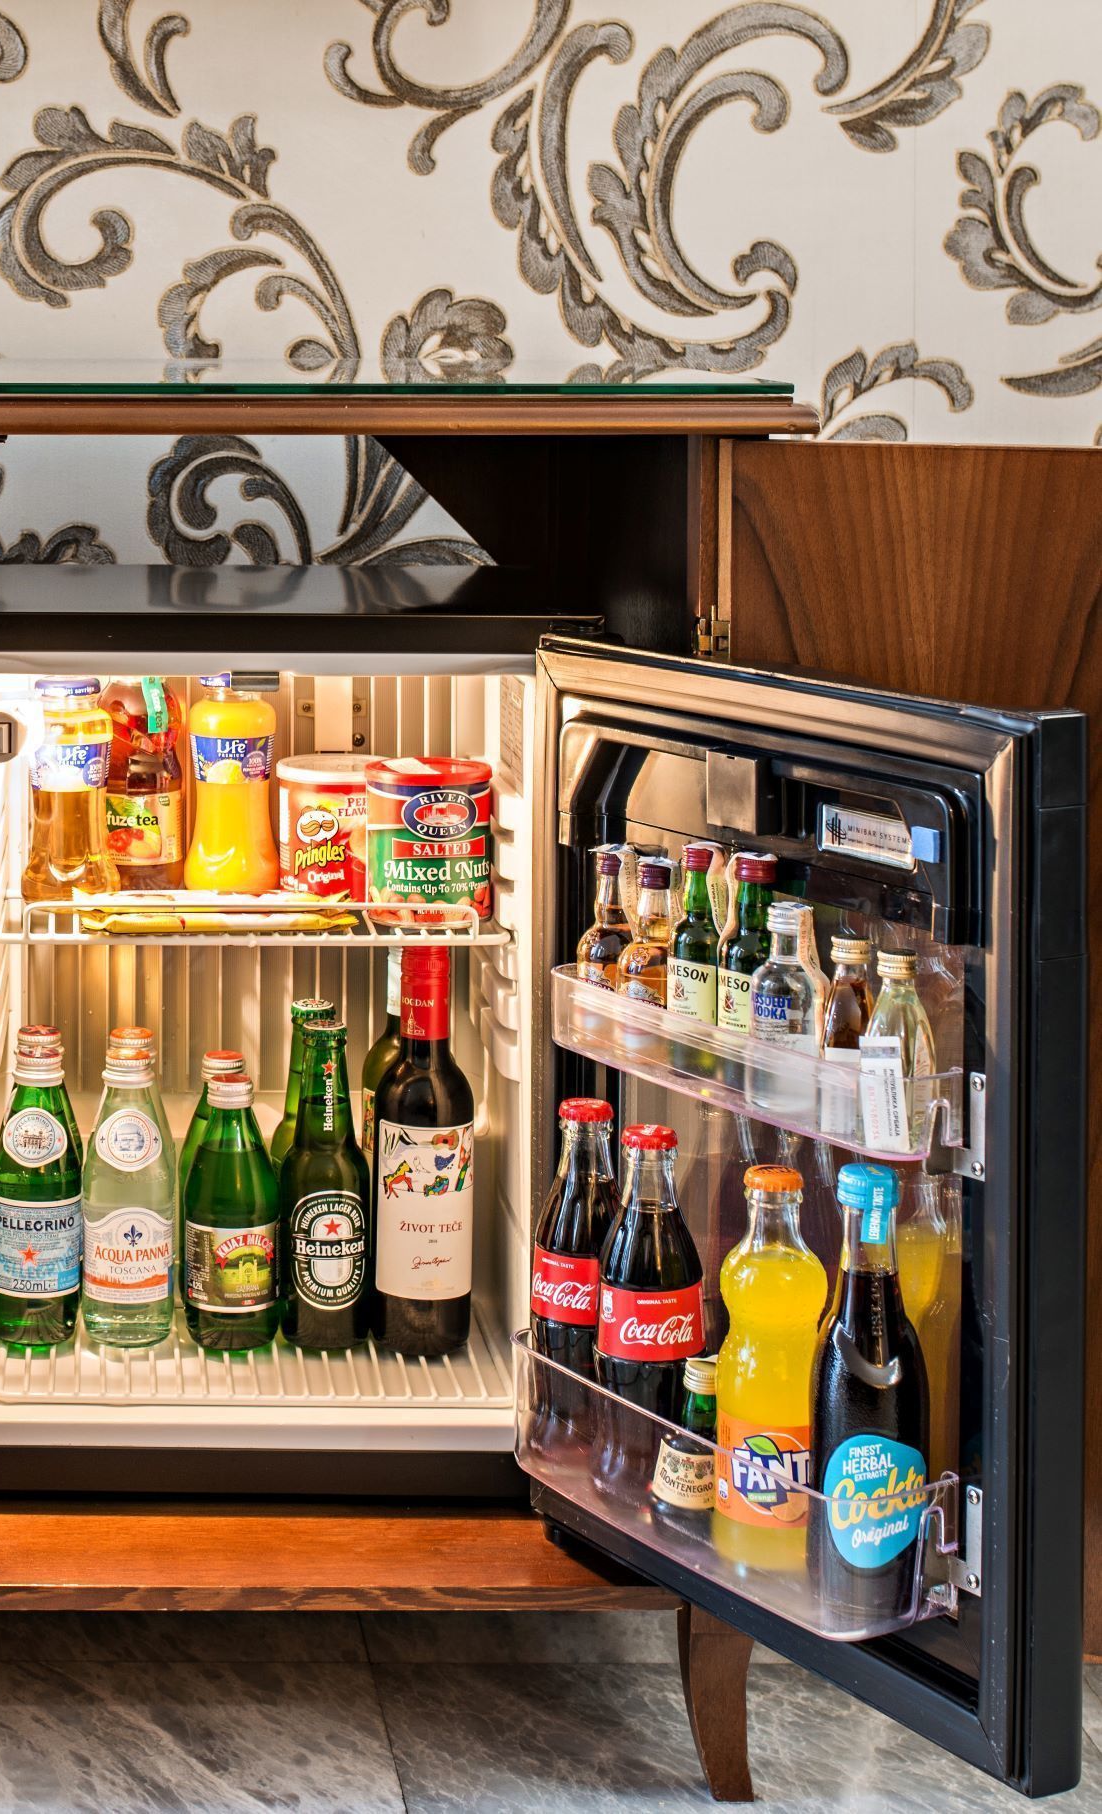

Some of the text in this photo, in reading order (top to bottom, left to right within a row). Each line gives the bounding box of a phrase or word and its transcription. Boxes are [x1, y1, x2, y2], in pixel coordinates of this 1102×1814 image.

[418, 793, 467, 806] RIVER
[416, 821, 468, 837] QUEEN
[847, 825, 877, 838] MINIBAR
[294, 840, 346, 876] Pringles
[412, 842, 471, 856] SALTED
[307, 869, 345, 884] Original
[384, 859, 490, 882] Mixed Nuts
[387, 880, 421, 893] Contains
[422, 884, 438, 896] Up
[438, 883, 450, 894] To
[451, 882, 468, 893] 70%
[667, 964, 709, 984] MESON
[718, 974, 751, 993] MESO
[323, 1078, 334, 1132] Heineken
[873, 1186, 885, 1205] TASTE
[300, 1203, 362, 1230] HEINEKEN LAGER BEER
[399, 1220, 464, 1234] ŽIVOT TEČE
[94, 1245, 133, 1265] ACQUA
[135, 1242, 170, 1262] PANNA
[295, 1238, 366, 1257] Heineken
[110, 1265, 157, 1275] TOSCANA
[301, 1269, 361, 1298] PREMIUM QUALITY
[849, 1444, 883, 1459] FINEST
[731, 1448, 810, 1492] FANT
[842, 1453, 896, 1476] HERBAL
[854, 1469, 888, 1482] EXTRACTS
[832, 1466, 928, 1530] Cockta
[851, 1514, 910, 1549] Original
